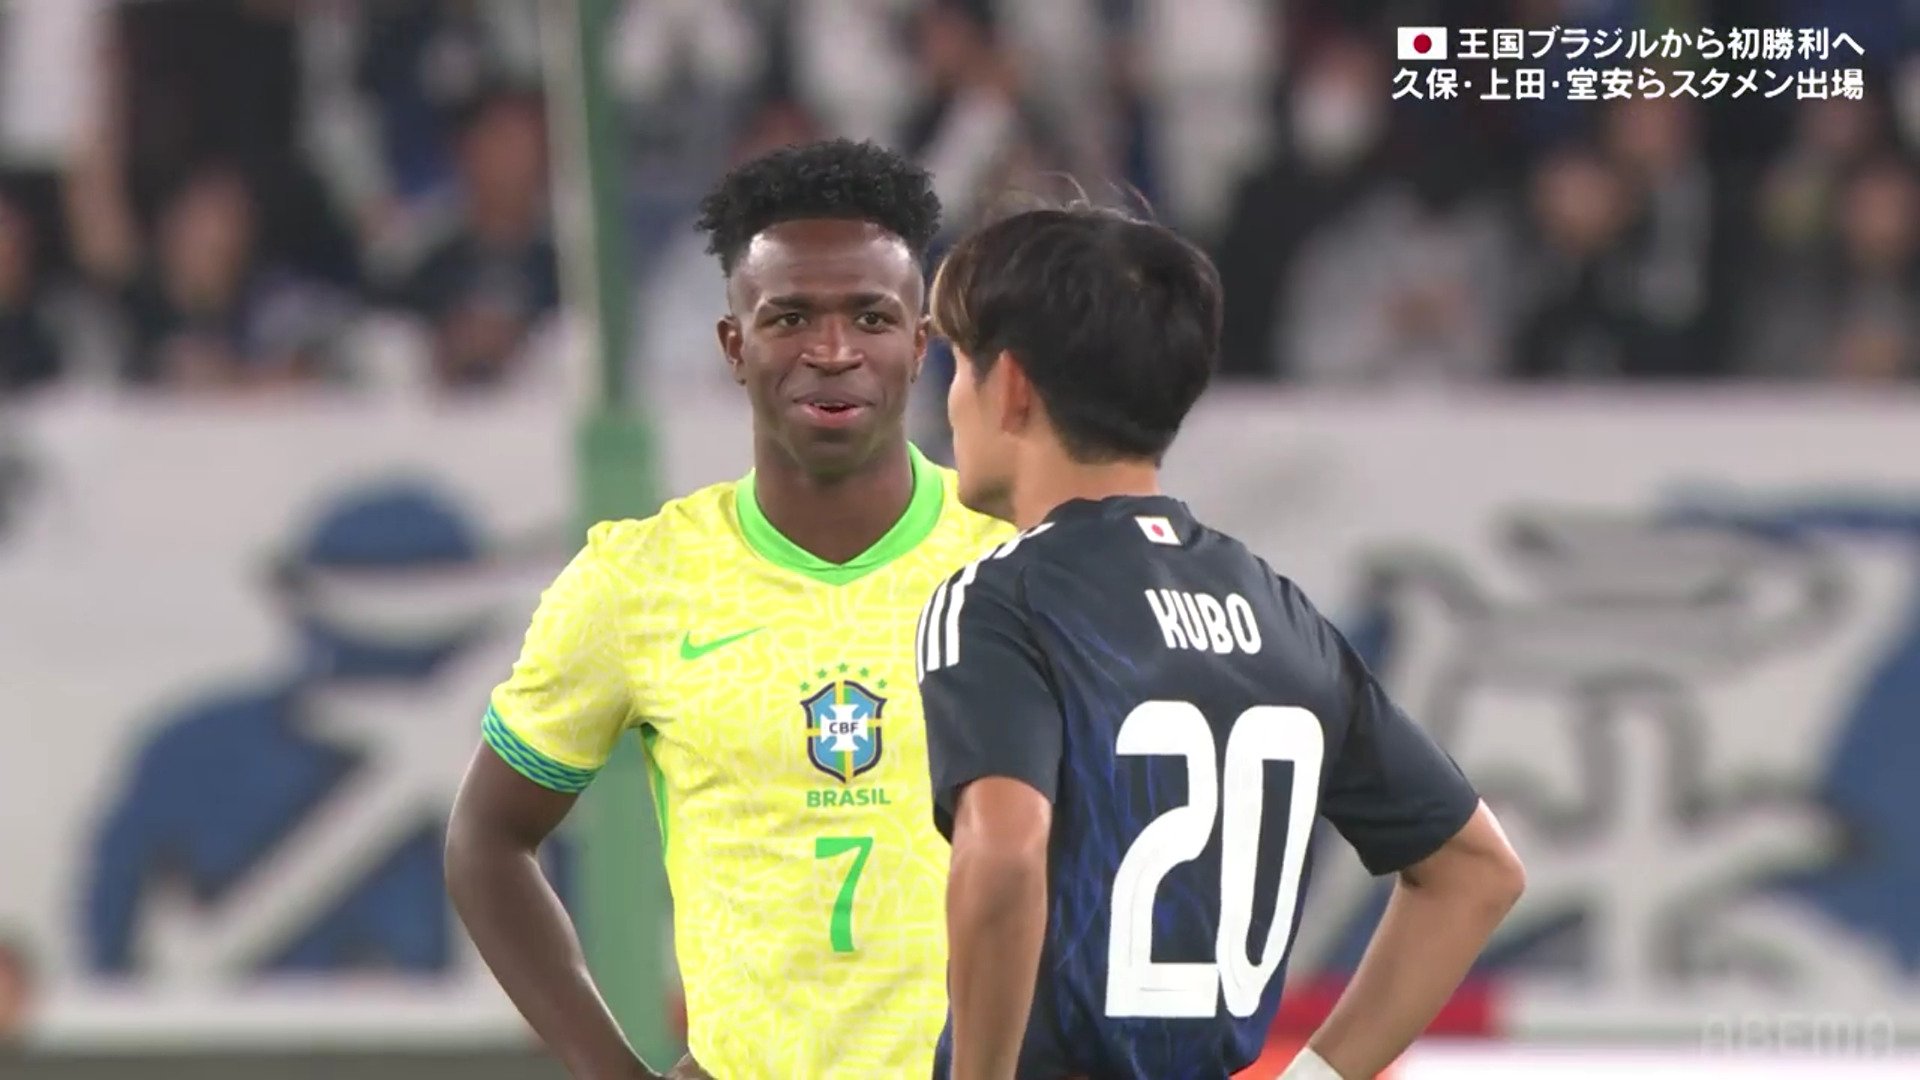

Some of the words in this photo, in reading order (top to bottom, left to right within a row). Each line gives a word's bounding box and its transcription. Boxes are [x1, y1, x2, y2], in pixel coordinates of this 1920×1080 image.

[1145, 588, 1261, 654] KUBO
[828, 721, 860, 735] CBF
[806, 787, 892, 808] BRASIL
[1105, 701, 1325, 1018] 20
[815, 836, 874, 953] 7
